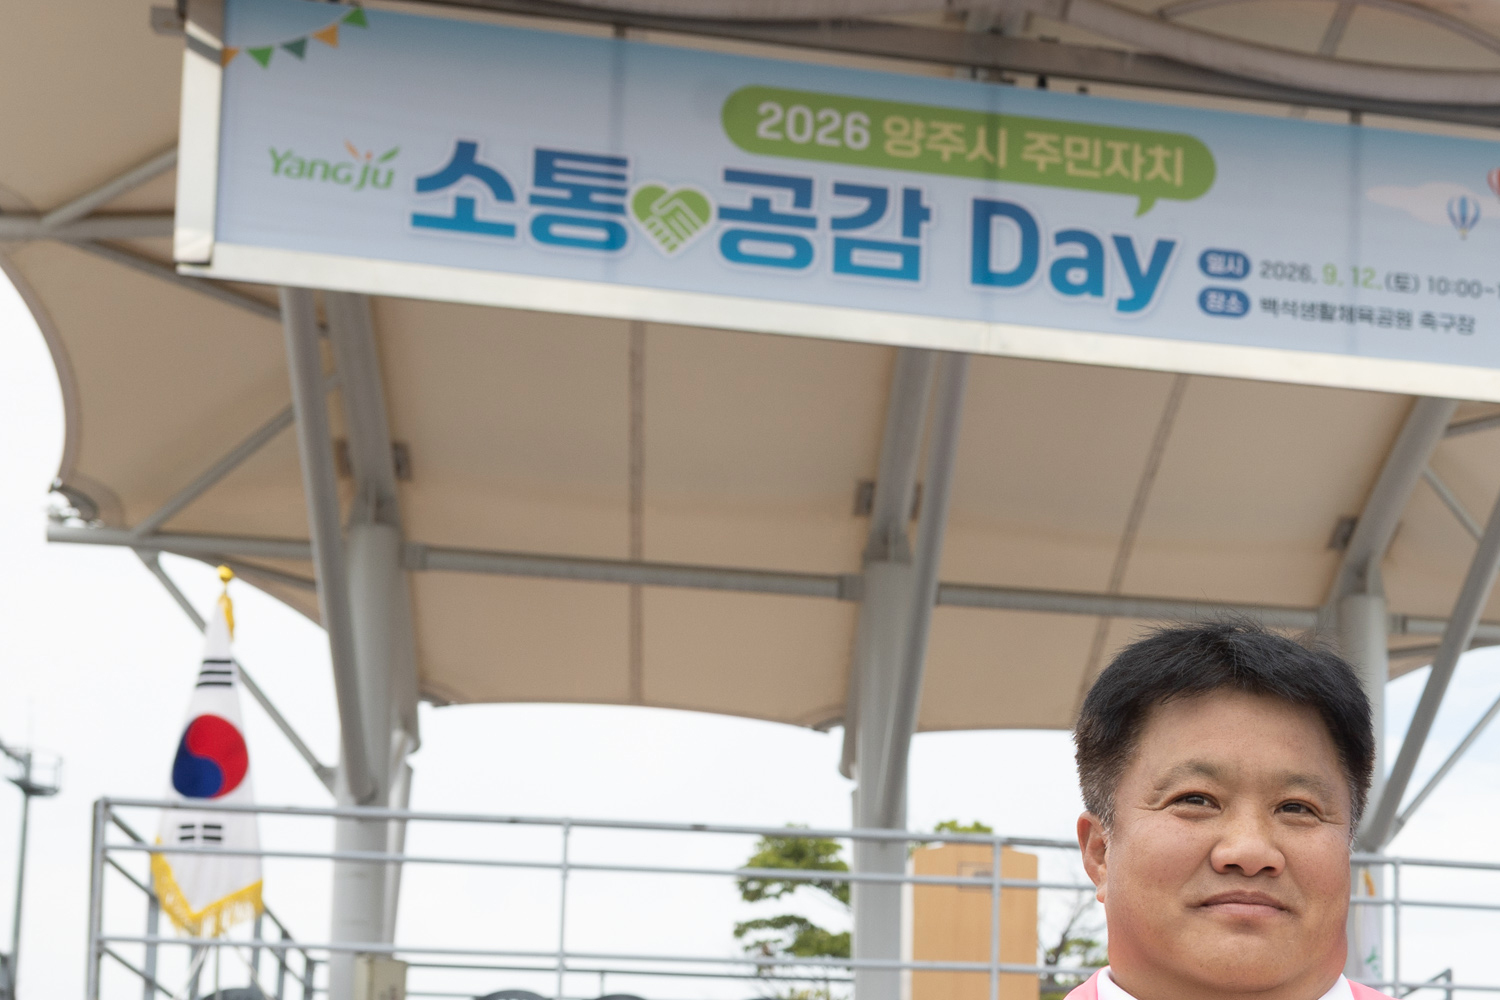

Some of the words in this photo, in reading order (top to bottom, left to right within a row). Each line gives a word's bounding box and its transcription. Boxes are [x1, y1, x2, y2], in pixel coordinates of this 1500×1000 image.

[757, 102, 870, 151] 2026
[882, 115, 1007, 168] 양주시
[1021, 131, 1184, 187] 주민자치
[411, 140, 629, 254] 소통
[717, 167, 932, 283] 공감
[970, 197, 1177, 314] Day
[1206, 253, 1244, 276] 일시
[1259, 259, 1317, 285] 2026.
[1322, 263, 1344, 287] 9.
[1206, 289, 1244, 314] 장소
